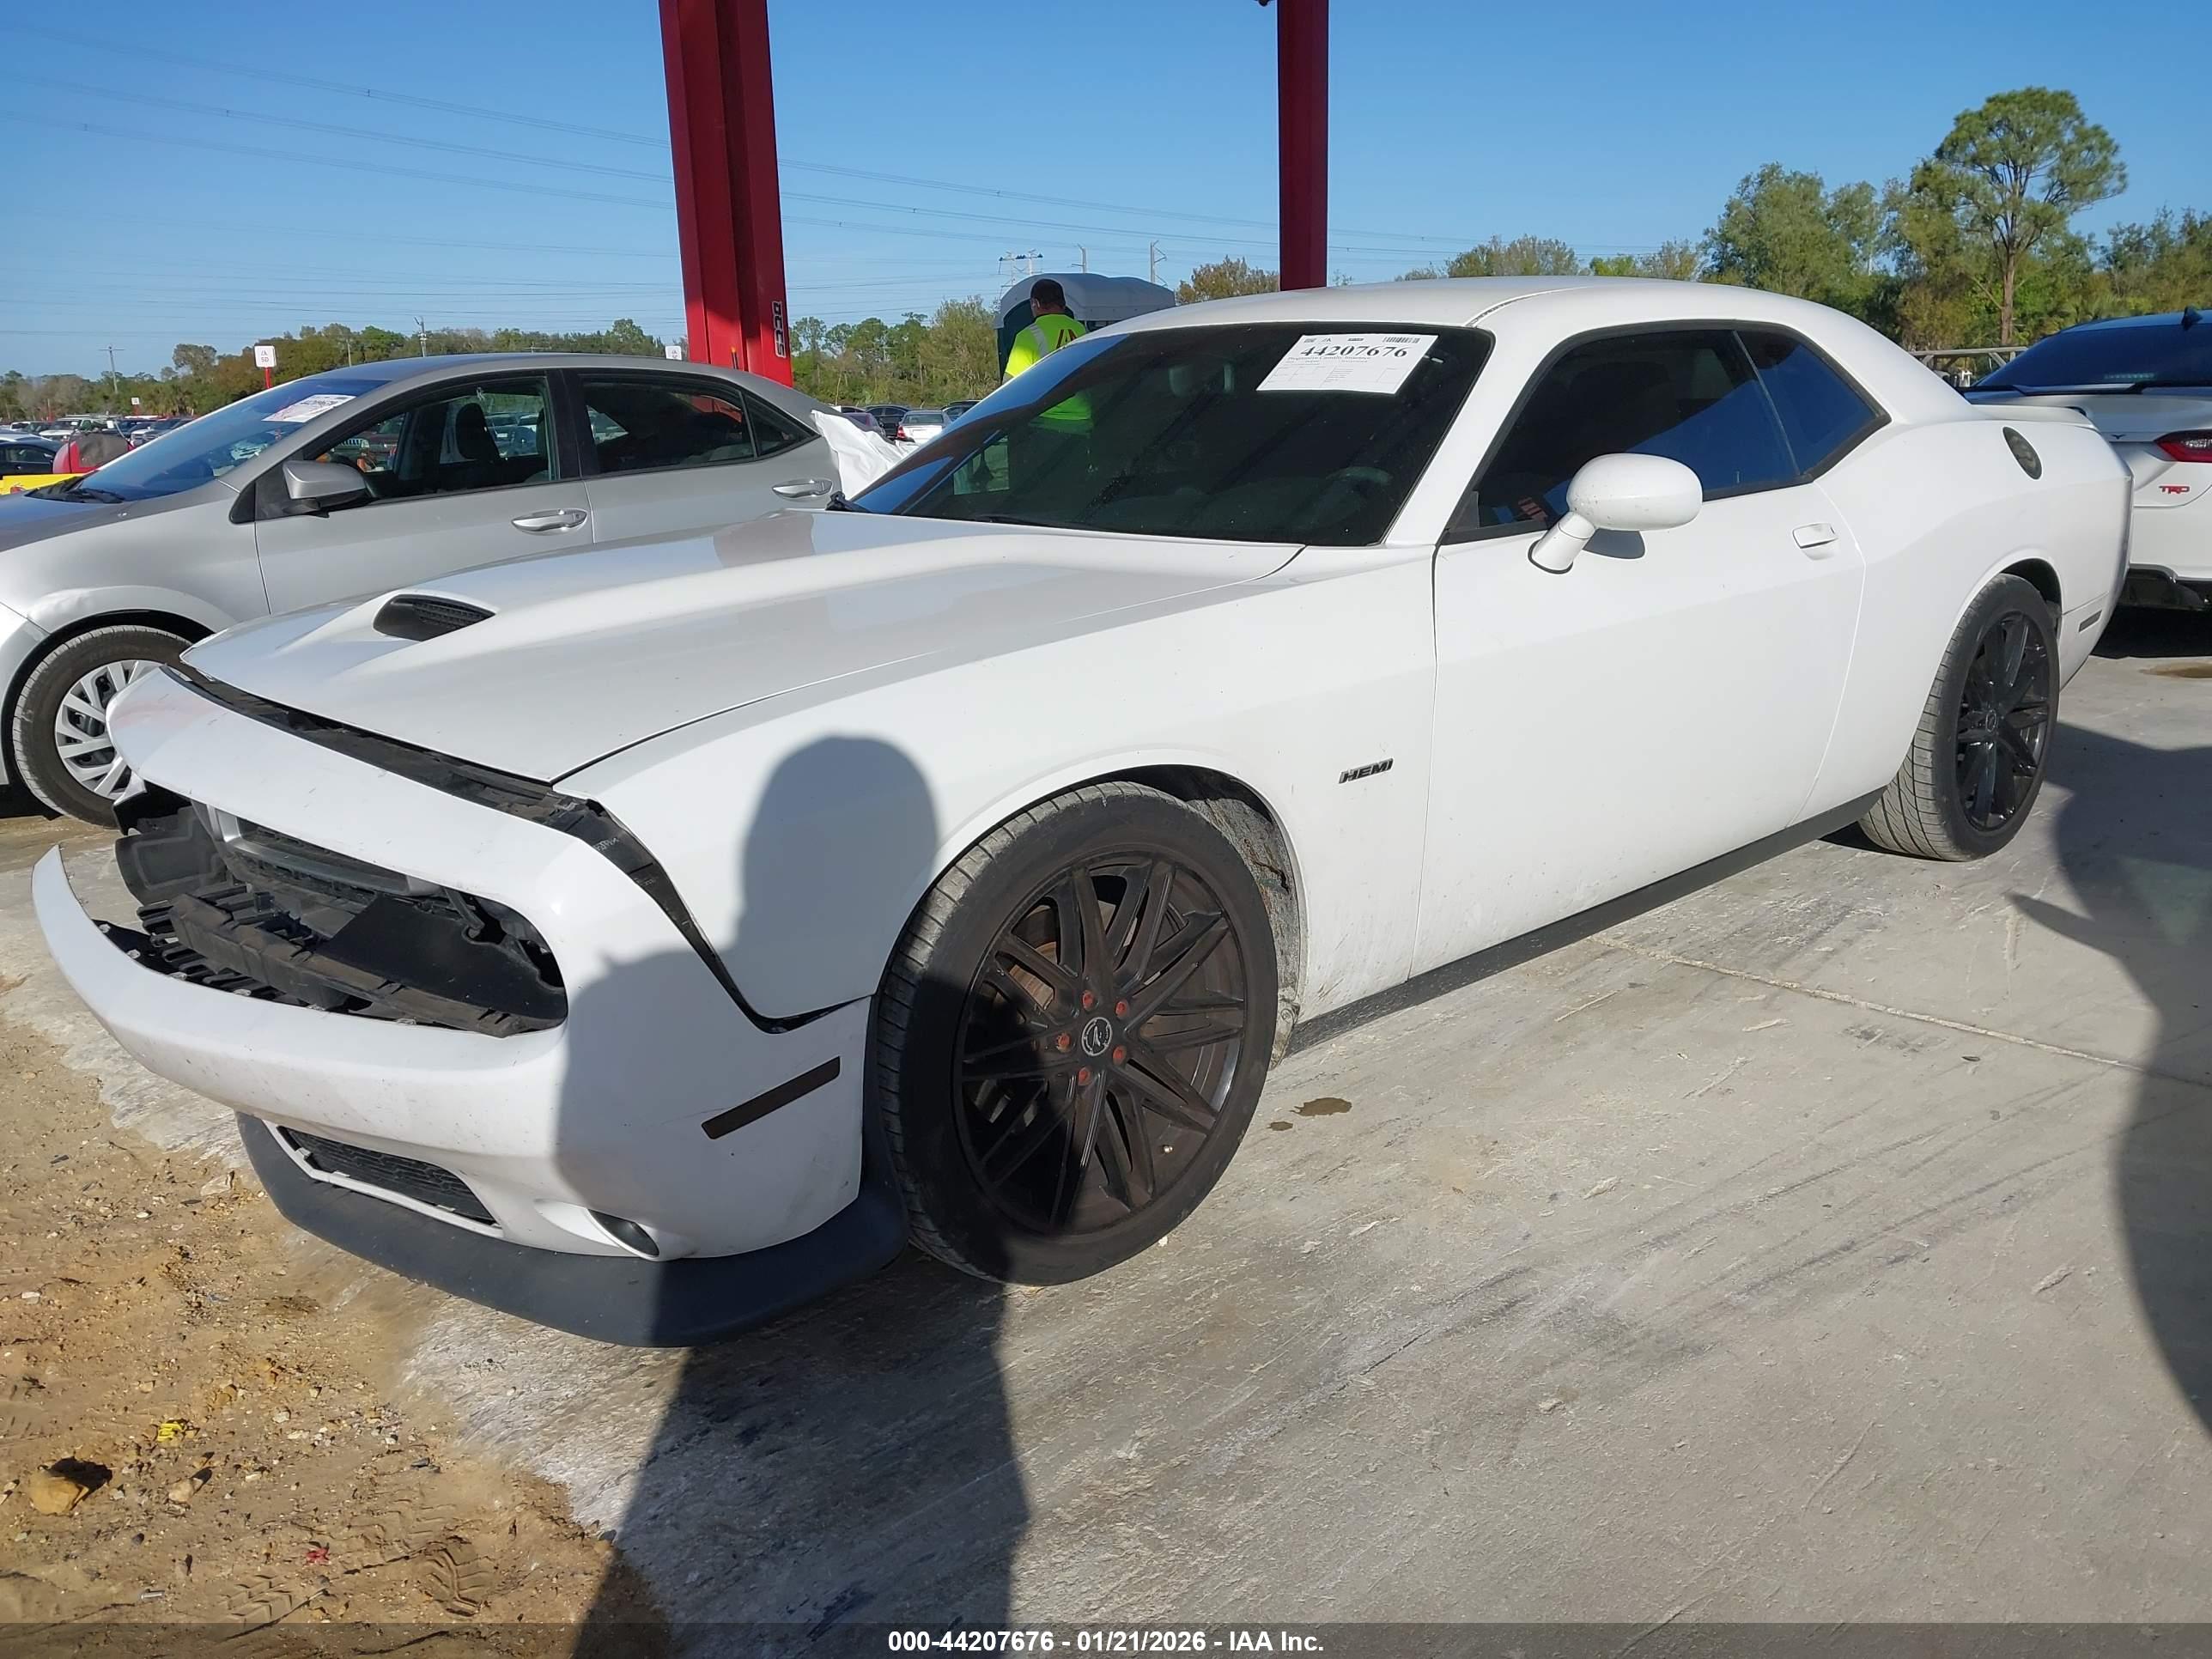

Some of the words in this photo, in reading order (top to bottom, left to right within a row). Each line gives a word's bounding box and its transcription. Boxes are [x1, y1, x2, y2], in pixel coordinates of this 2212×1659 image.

[1301, 345, 1409, 358] 44207676
[2158, 485, 2190, 494] TRD
[1338, 757, 1394, 784] HEMI
